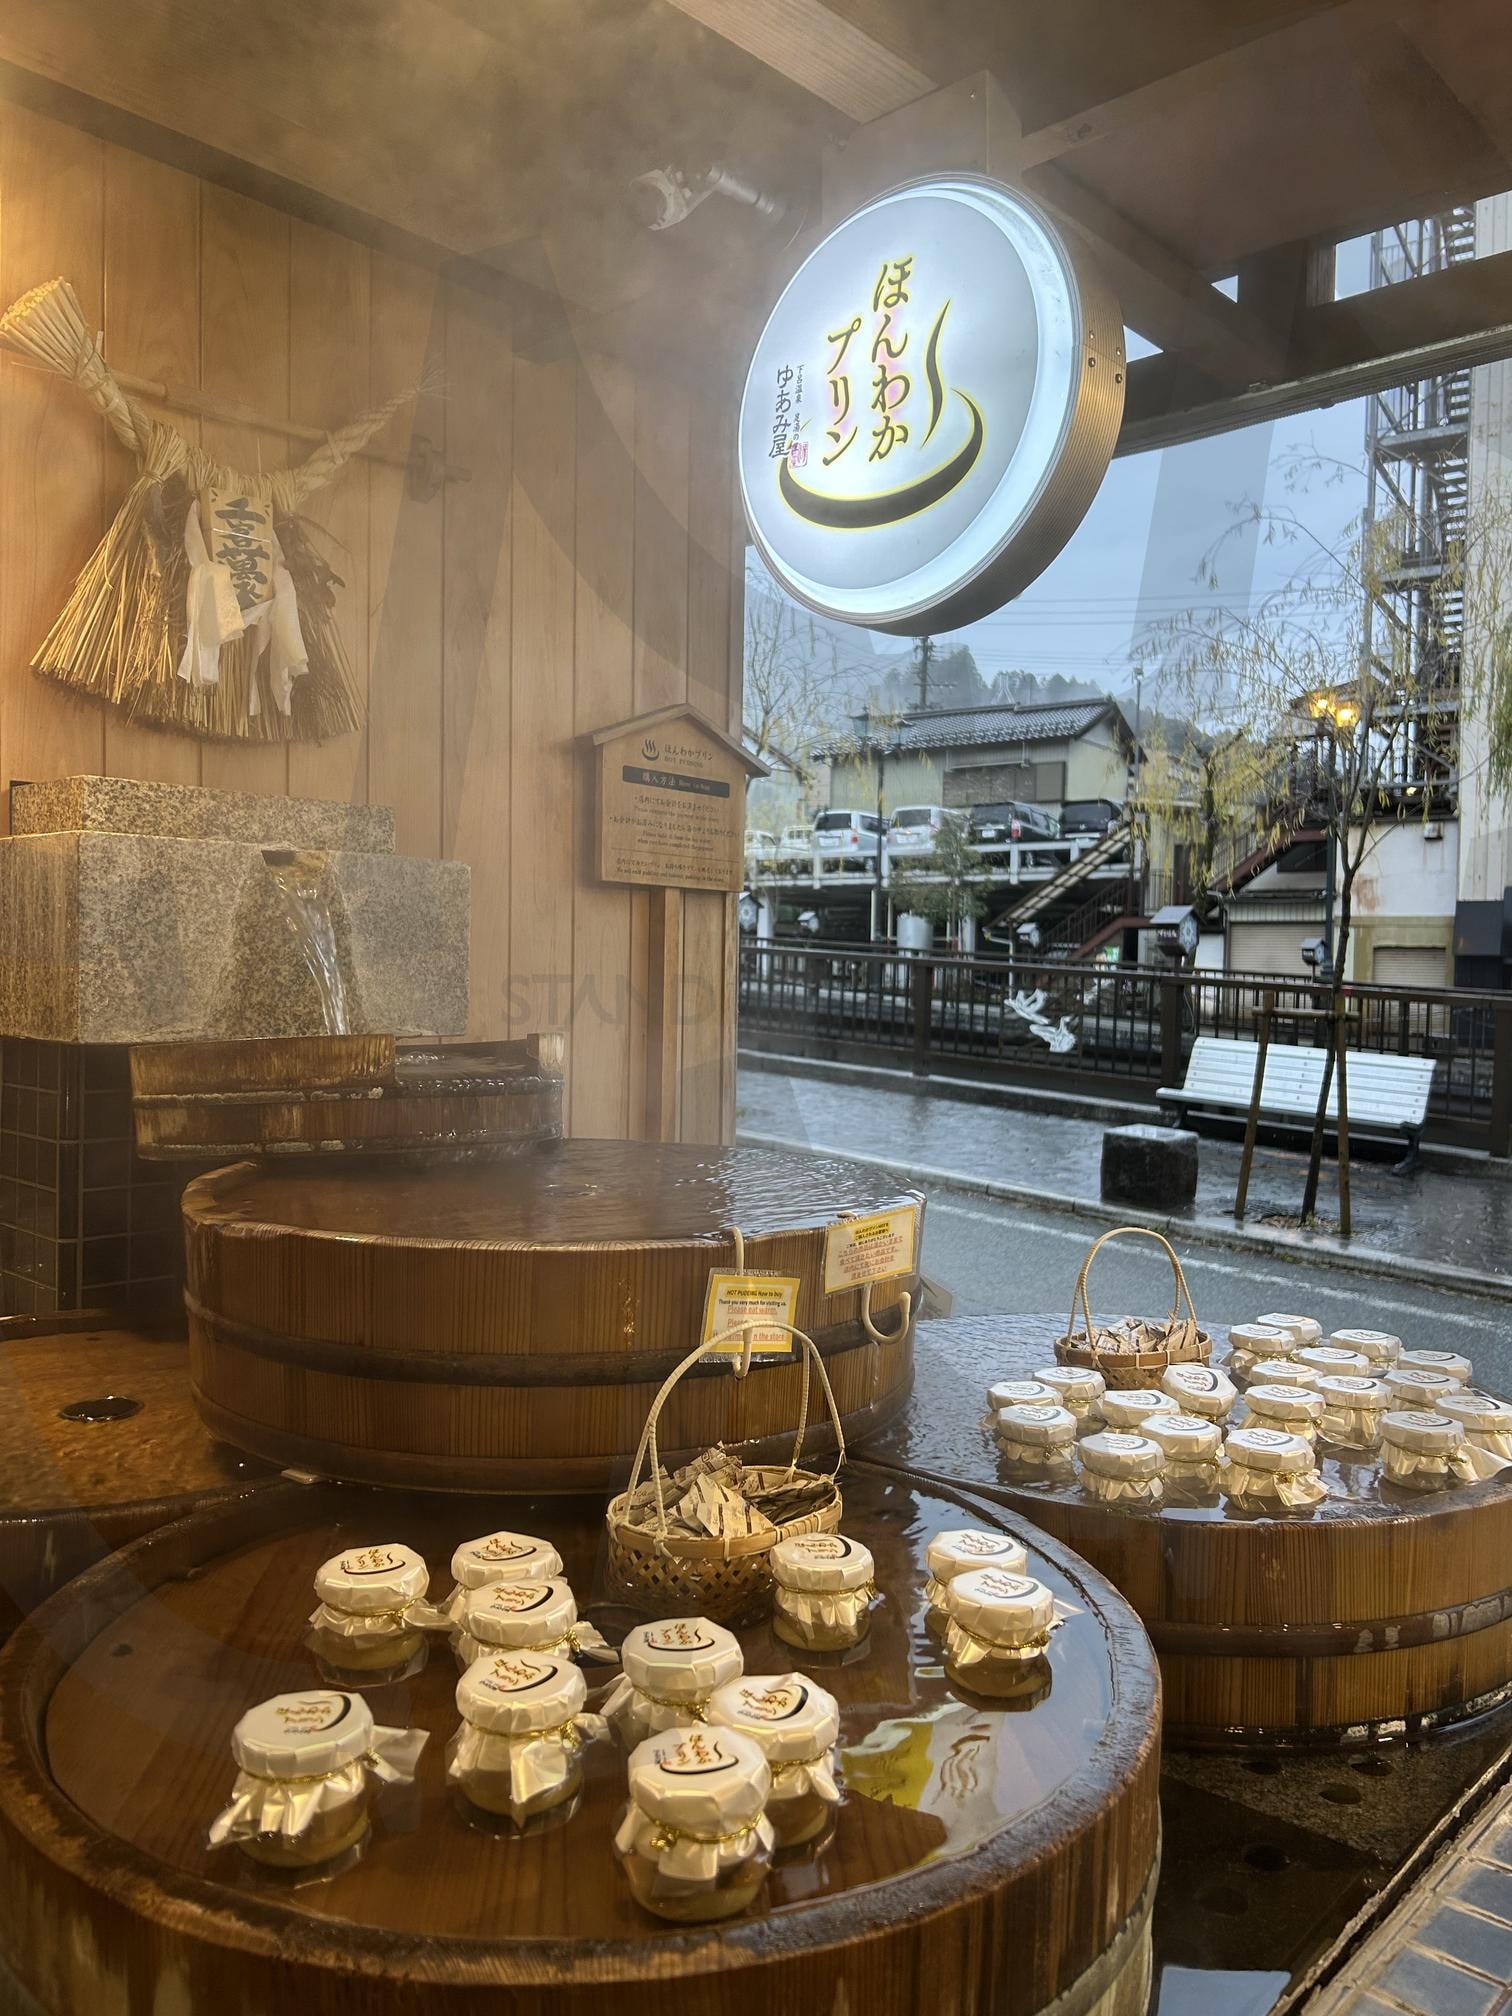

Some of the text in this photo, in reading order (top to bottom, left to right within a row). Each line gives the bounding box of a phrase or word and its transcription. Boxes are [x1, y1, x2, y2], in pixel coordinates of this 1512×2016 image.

[821, 317, 862, 467] プリン
[868, 257, 913, 462] ほんわか
[768, 364, 794, 459] ゆあみ屋
[664, 743, 714, 761] ほんわかプリン
[728, 1305, 747, 1313] Please
